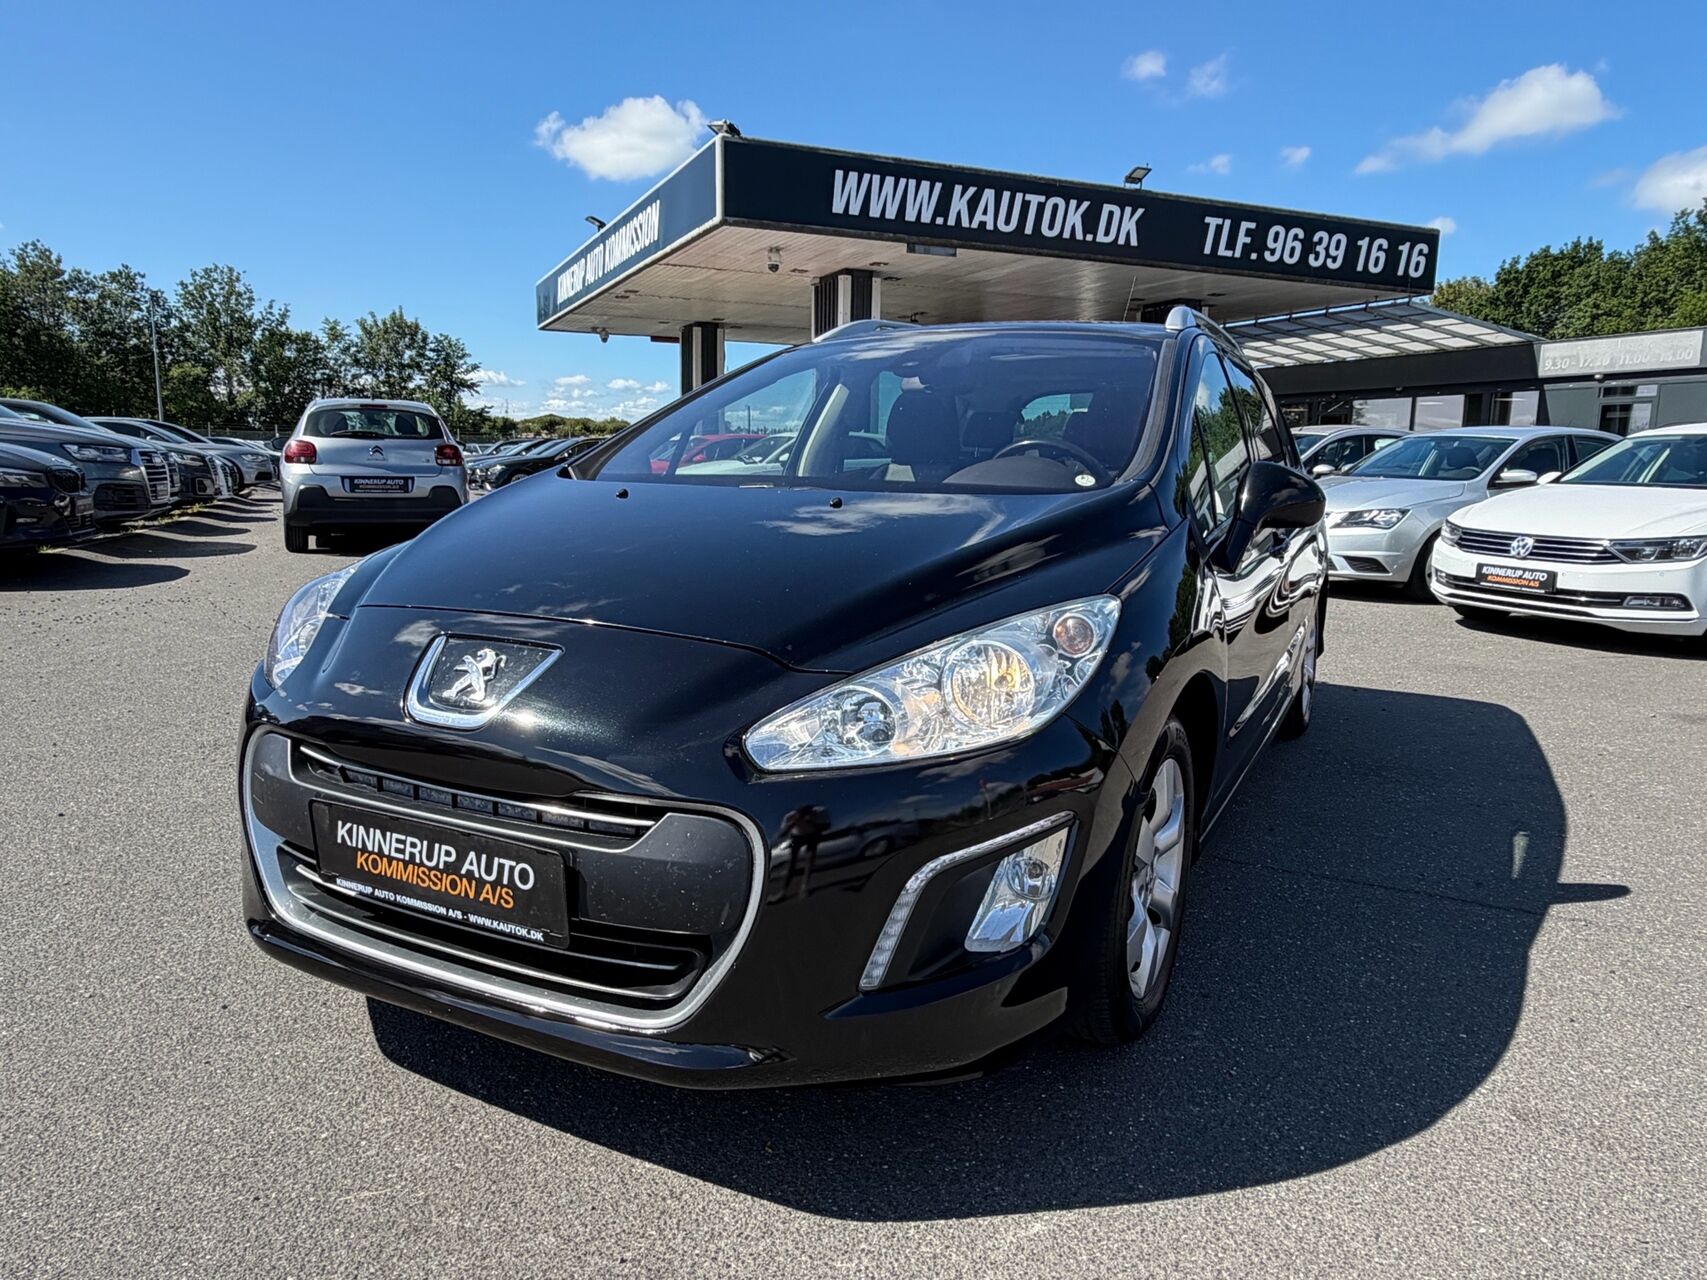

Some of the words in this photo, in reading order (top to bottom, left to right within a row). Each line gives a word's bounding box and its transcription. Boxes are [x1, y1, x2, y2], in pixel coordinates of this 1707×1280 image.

[831, 168, 1145, 248] WWW.KAUTOK.DK
[558, 258, 585, 304] KINNERUP
[586, 244, 604, 285] AUTO
[605, 200, 660, 273] KOMMISSION
[1202, 216, 1259, 260] TLF.
[1264, 224, 1304, 265] 96
[1308, 230, 1346, 270] 39
[1356, 236, 1387, 274] 16
[1396, 241, 1430, 279] 16
[1482, 566, 1523, 577] KINNERUP
[1523, 571, 1548, 581] AUTO
[337, 820, 457, 870] KINNERUP
[460, 851, 535, 891] AUTO
[356, 851, 478, 898] KOMMISSION
[479, 885, 515, 909] A/S
[336, 877, 374, 895] KINNERUP
[374, 887, 395, 902] AUTO
[396, 893, 447, 916] KOMMISSION
[448, 908, 463, 920] A/S
[468, 913, 545, 942] WWW.KAUTOK.DK
